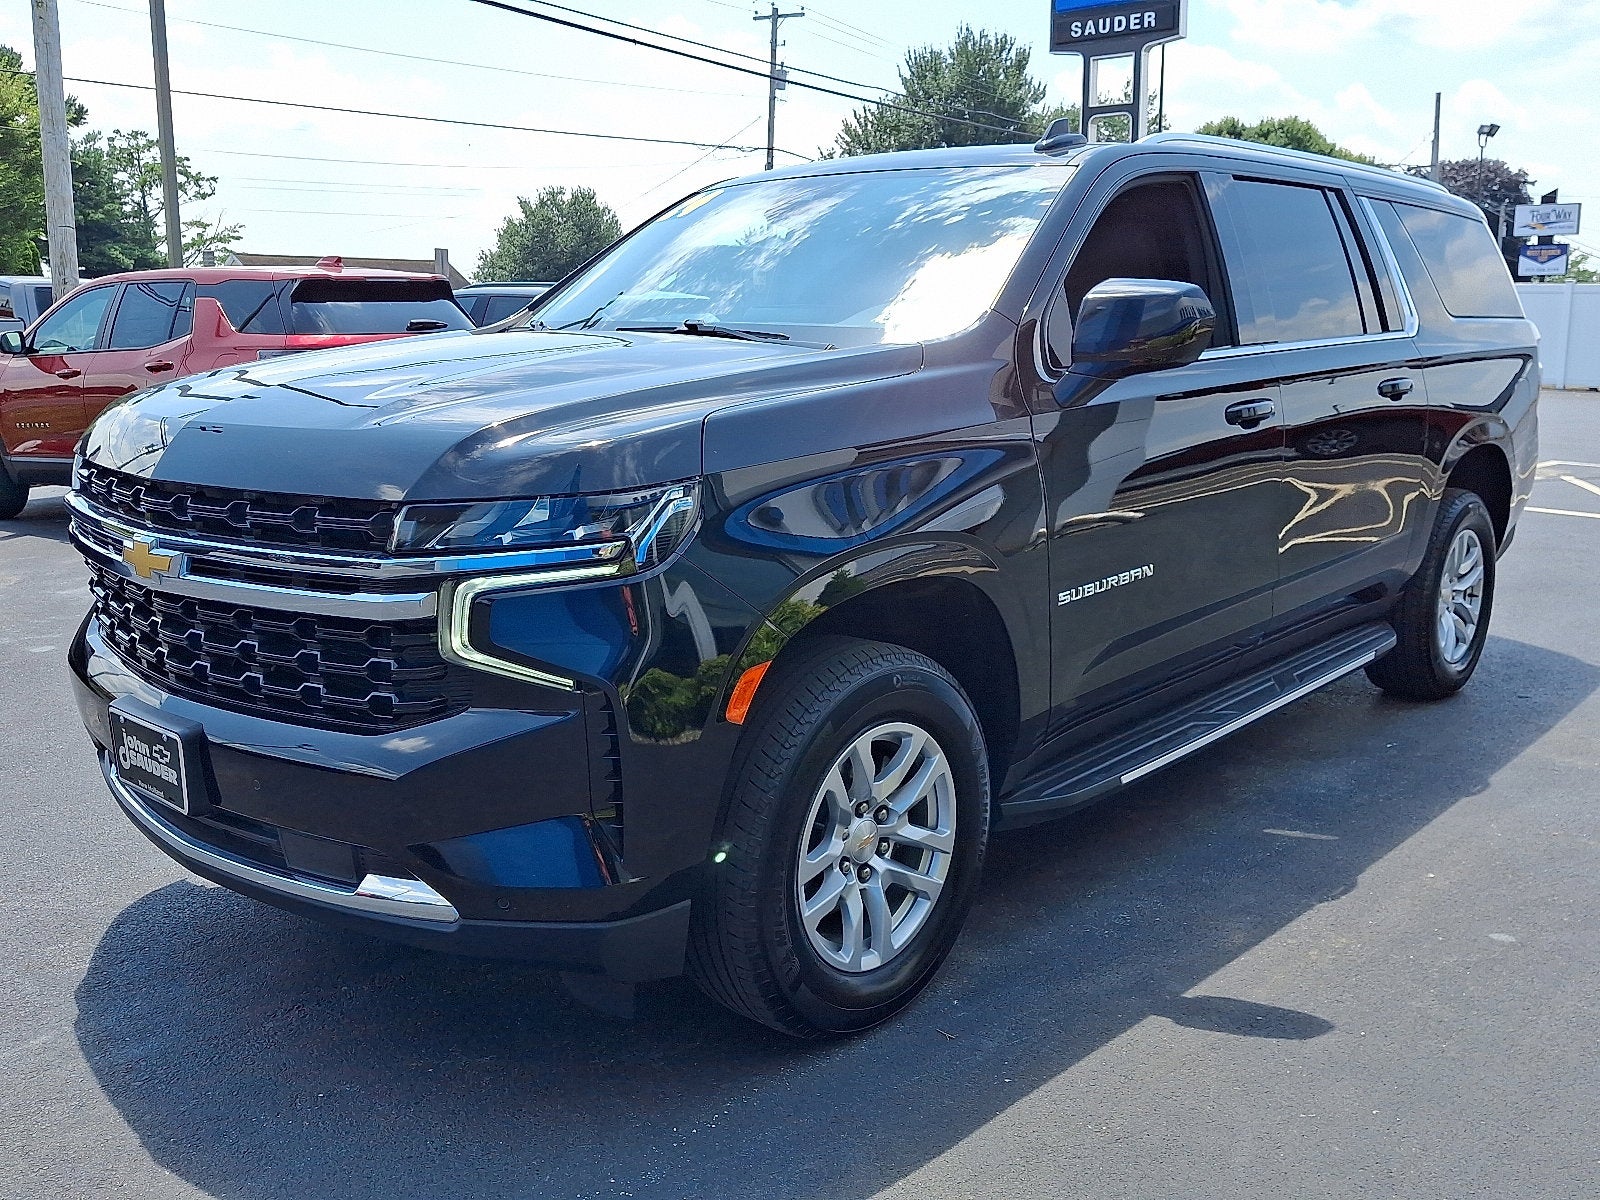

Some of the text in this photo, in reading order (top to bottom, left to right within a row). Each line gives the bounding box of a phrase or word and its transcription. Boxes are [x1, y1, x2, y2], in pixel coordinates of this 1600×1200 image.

[1070, 11, 1156, 38] SAUDER
[1057, 563, 1154, 607] SUBURBAN
[129, 749, 179, 787] SAUDER
